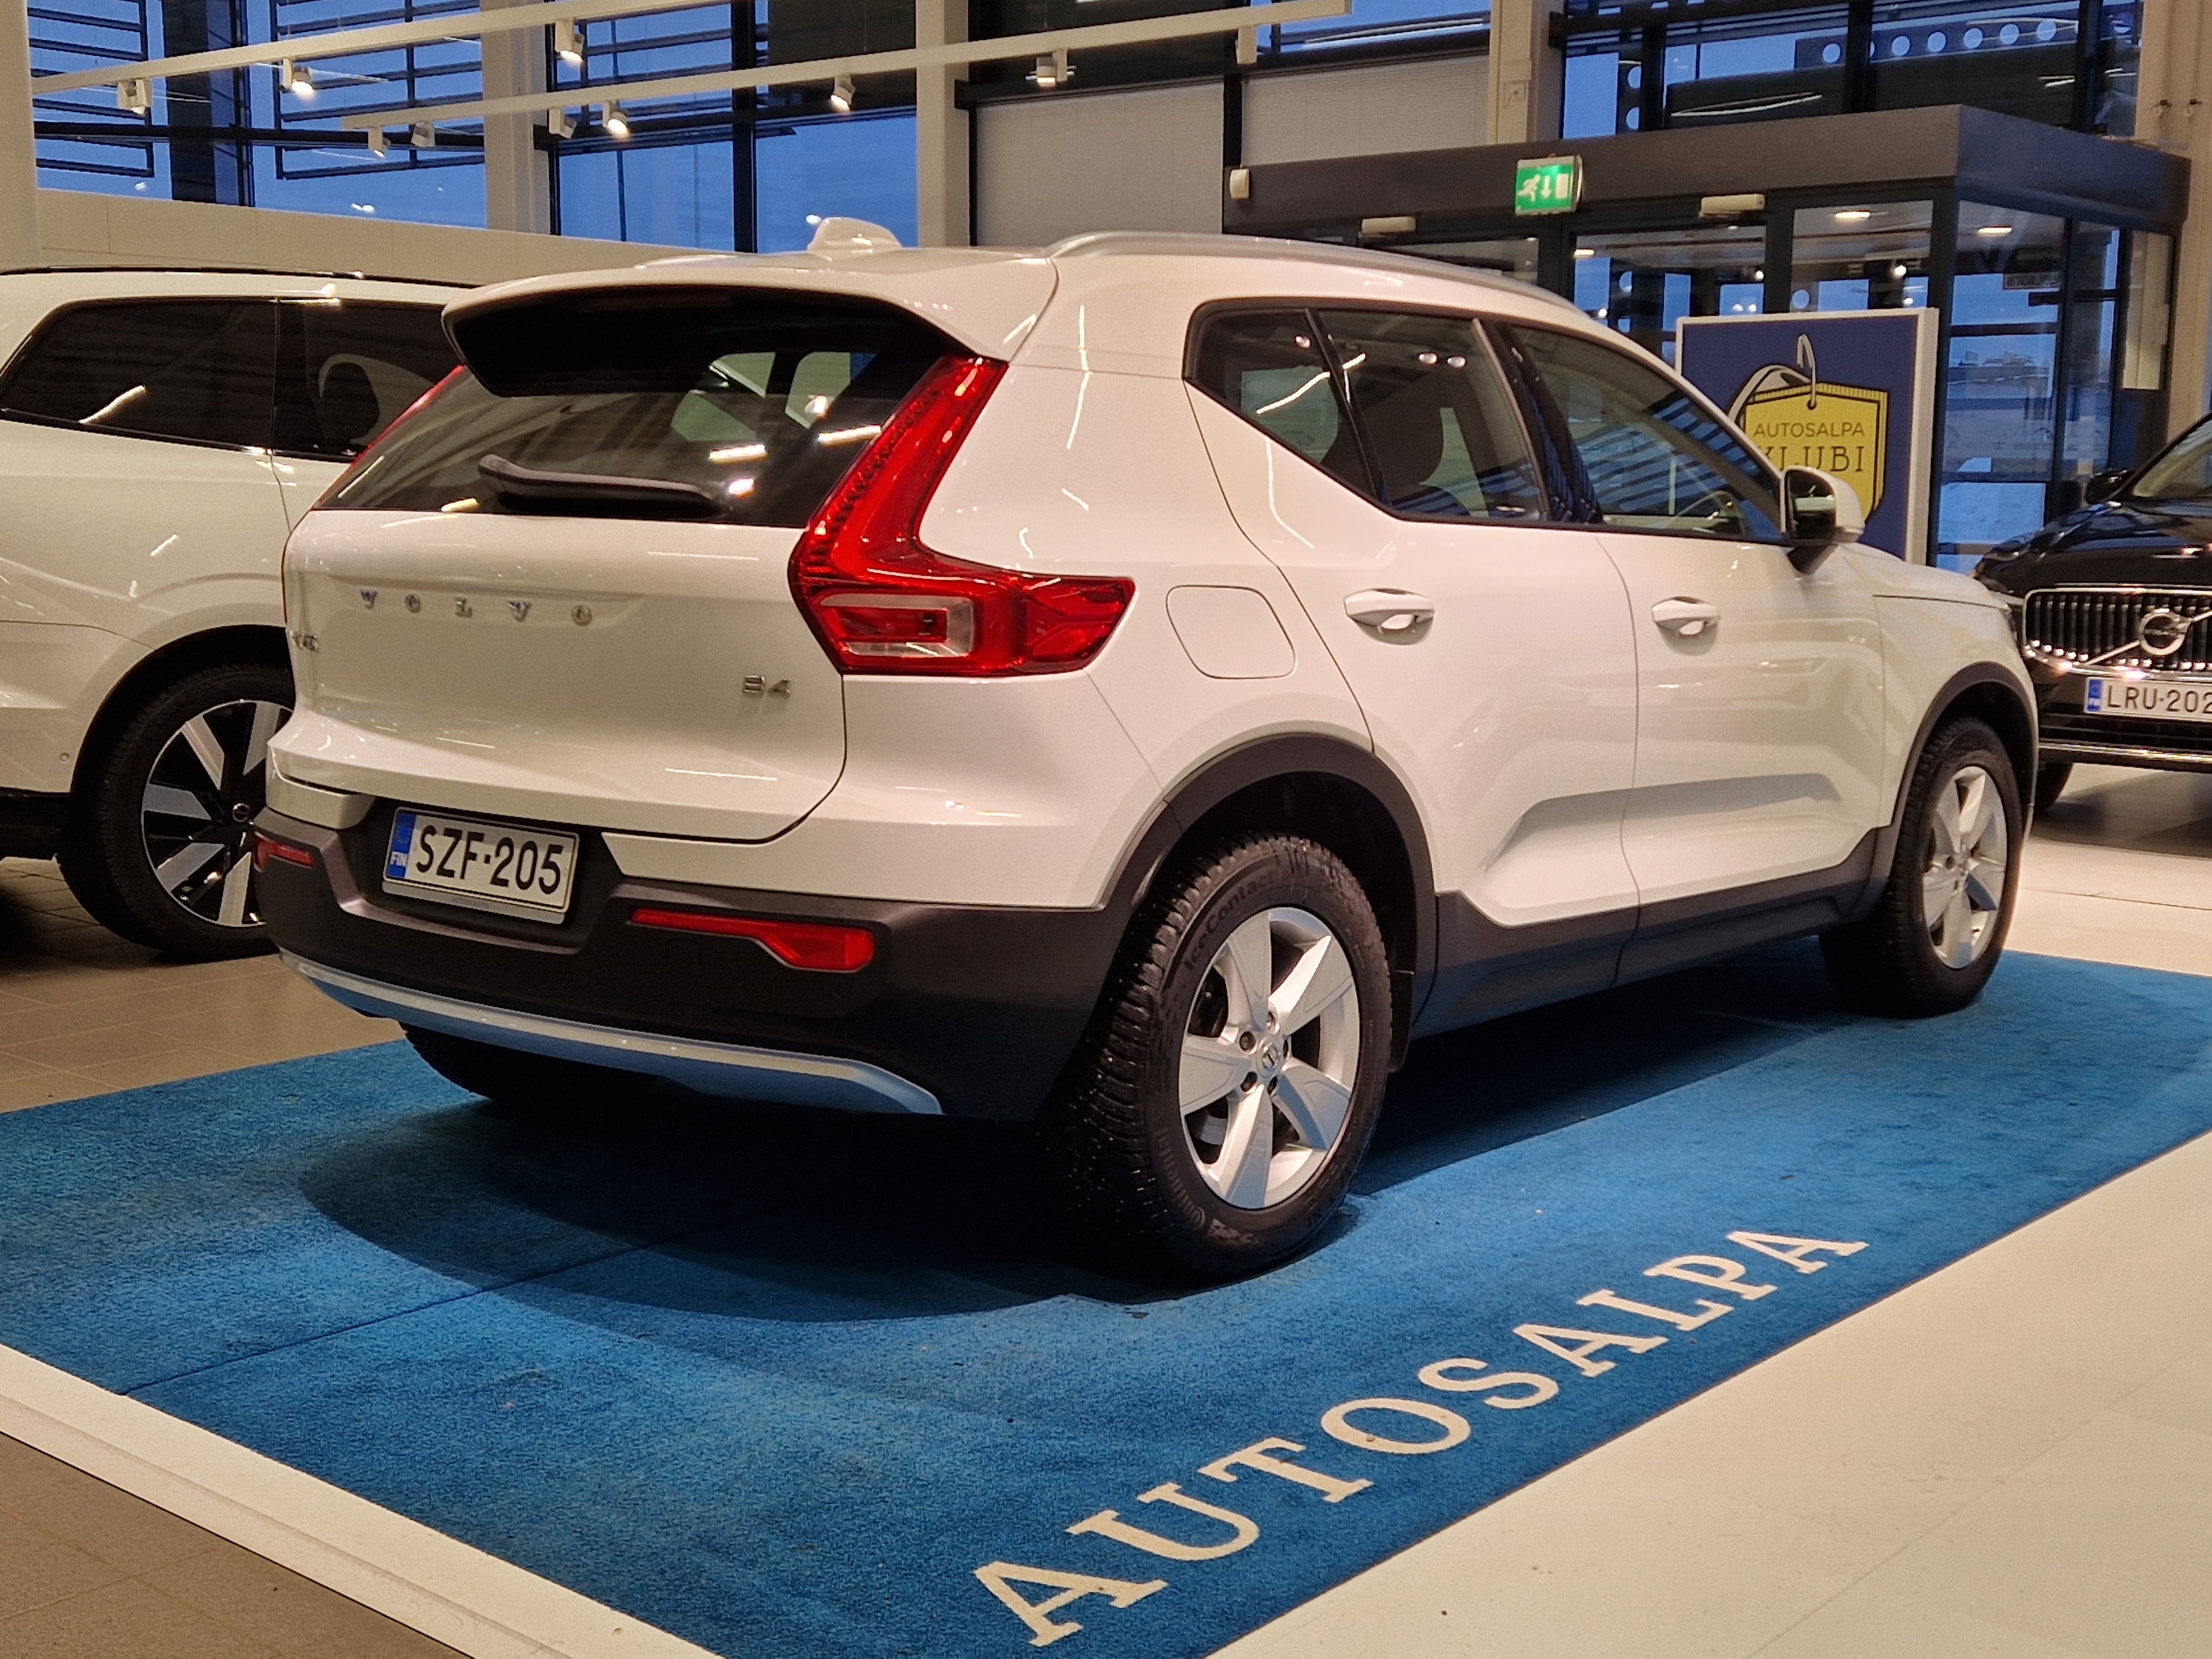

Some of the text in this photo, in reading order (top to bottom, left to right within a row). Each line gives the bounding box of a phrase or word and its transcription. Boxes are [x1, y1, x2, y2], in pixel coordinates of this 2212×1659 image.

[1753, 422, 1865, 437] AUTOSALPA
[359, 588, 593, 626] VOLVO
[742, 675, 791, 699] B4
[390, 851, 408, 867] FIN
[415, 825, 564, 895] SZF-205
[974, 1230, 1869, 1647] AUTOSALPA
